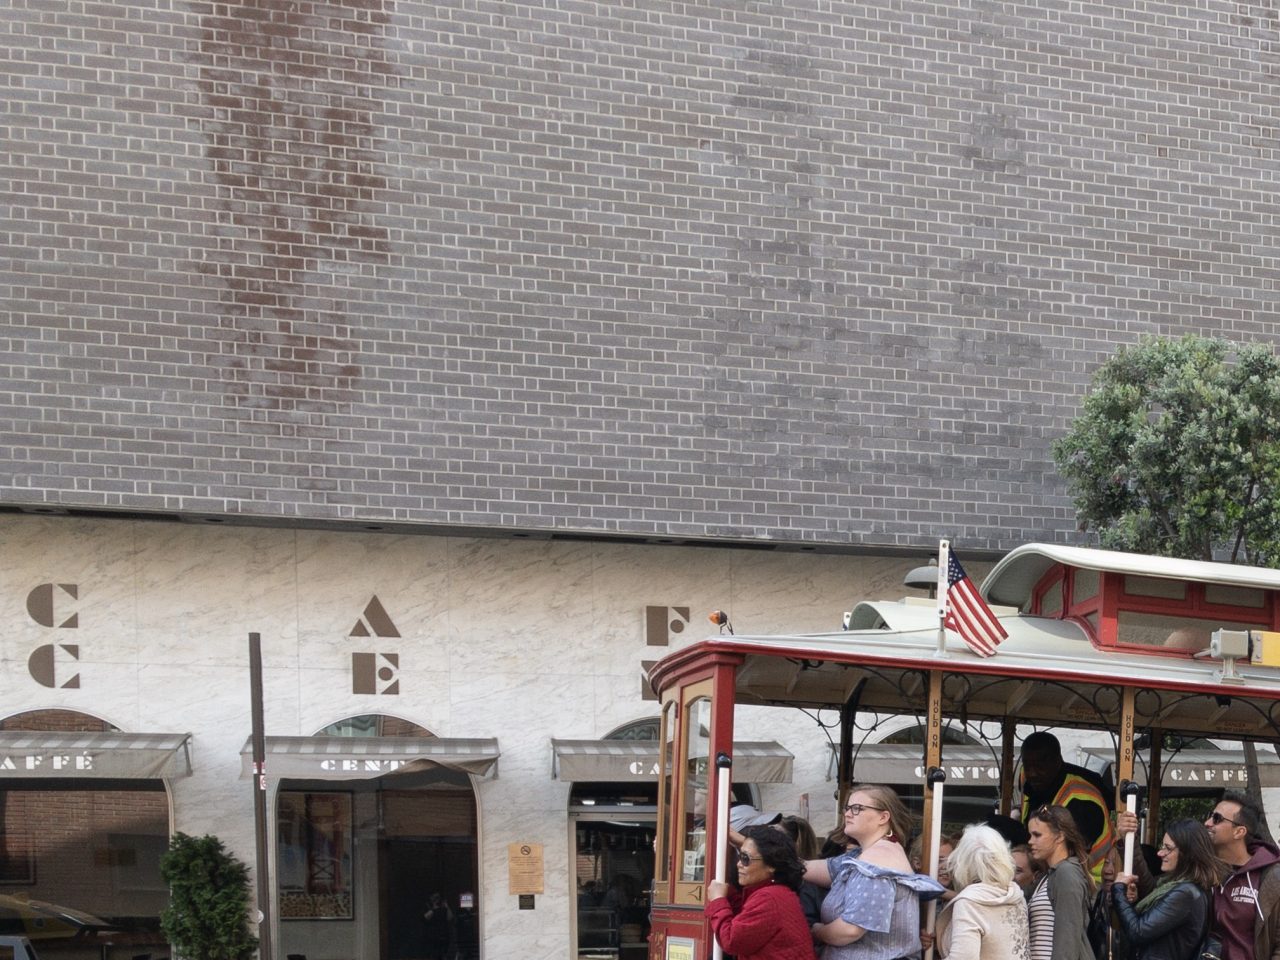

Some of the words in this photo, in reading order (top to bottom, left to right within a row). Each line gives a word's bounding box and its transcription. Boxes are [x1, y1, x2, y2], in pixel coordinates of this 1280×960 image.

[932, 734, 938, 748] ON
[0, 751, 92, 769] AFFÉ
[1125, 748, 1131, 761] ON
[321, 760, 405, 771] CENT
[914, 766, 1000, 779] CNTO
